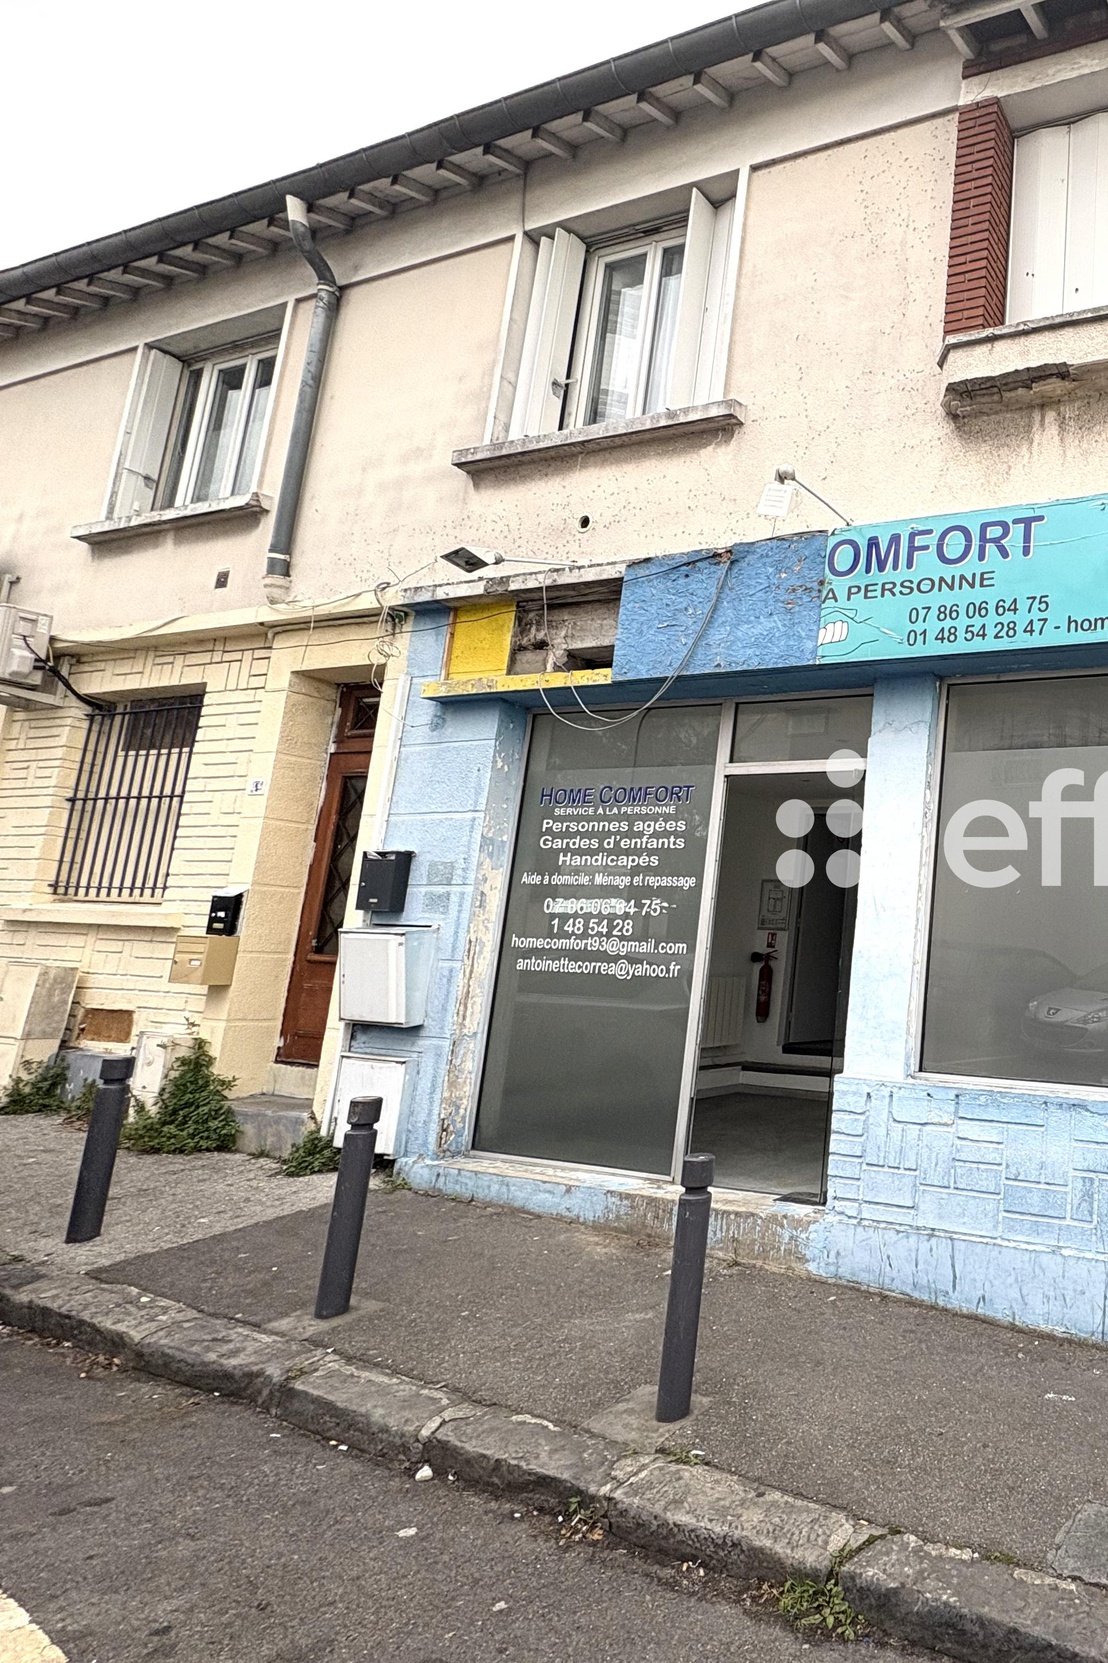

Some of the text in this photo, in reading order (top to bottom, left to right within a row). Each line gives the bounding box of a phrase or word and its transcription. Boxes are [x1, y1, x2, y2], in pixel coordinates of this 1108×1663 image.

[828, 515, 1046, 578] OMFORT
[847, 571, 995, 602] PERSONNE
[908, 595, 1049, 624] 07 86 06 64 75
[906, 628, 927, 647] 01
[934, 626, 958, 644] 48
[964, 623, 987, 642] 54
[993, 620, 1017, 639] 28
[1023, 618, 1049, 636] 47
[540, 785, 695, 806] HOME COMFORT
[554, 807, 595, 816] SERVICE
[606, 806, 619, 815] LA
[621, 806, 676, 815] PERSONNE
[542, 817, 686, 834] Personnes agées
[540, 835, 685, 849] Gardes d'enfants
[558, 852, 659, 869] Handicapés
[521, 872, 696, 890] Aide à domicile: Ménage et repassage
[551, 918, 633, 936] 1 48 54 28
[511, 934, 687, 955] homecomfort93@gmail.com
